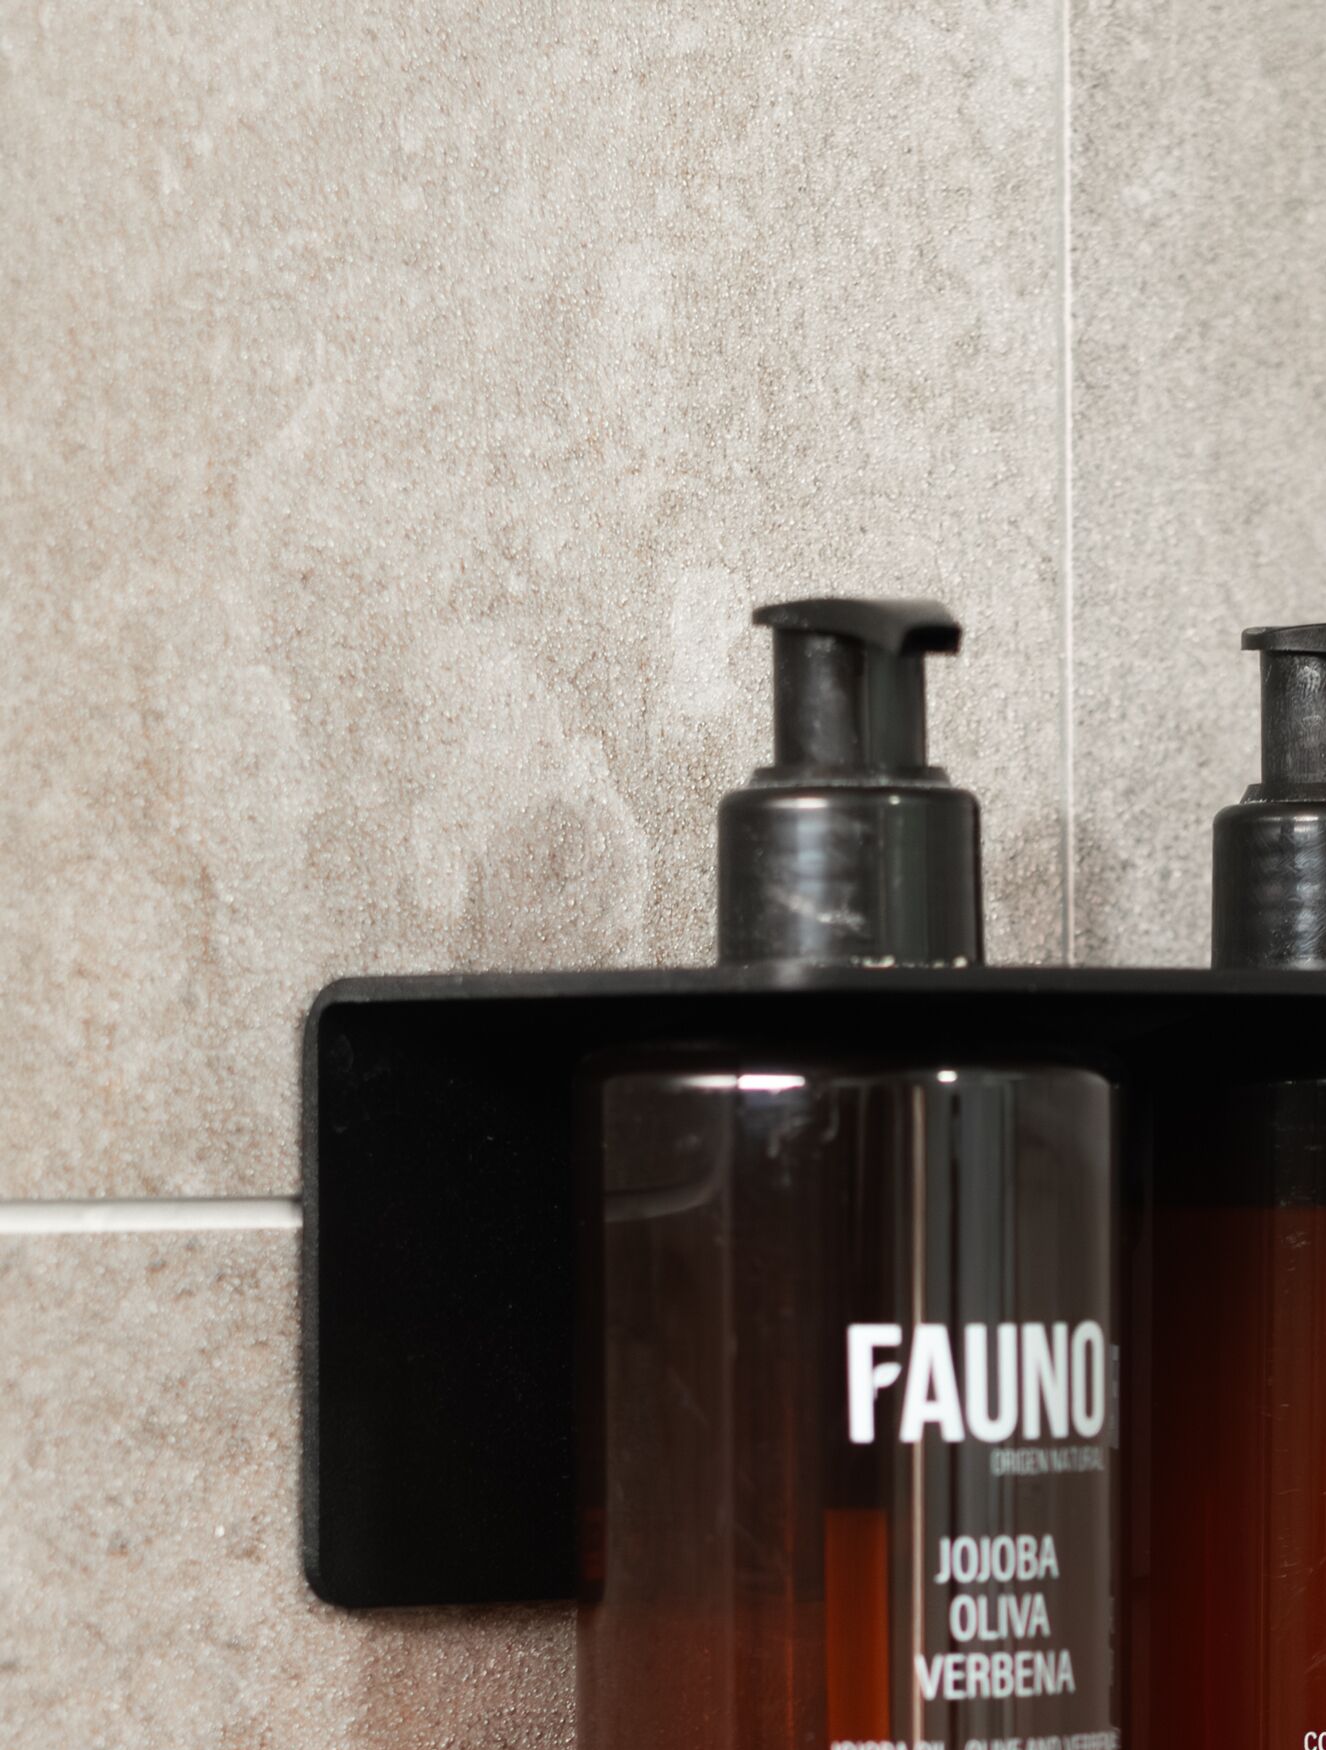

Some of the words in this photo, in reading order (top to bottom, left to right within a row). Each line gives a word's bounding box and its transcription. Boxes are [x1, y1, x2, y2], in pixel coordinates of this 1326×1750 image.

[847, 1321, 1105, 1444] FAUNO
[935, 1535, 1058, 1584] JOJOBA
[949, 1594, 1050, 1642] OLIVA
[915, 1650, 1075, 1700] VERBENA
